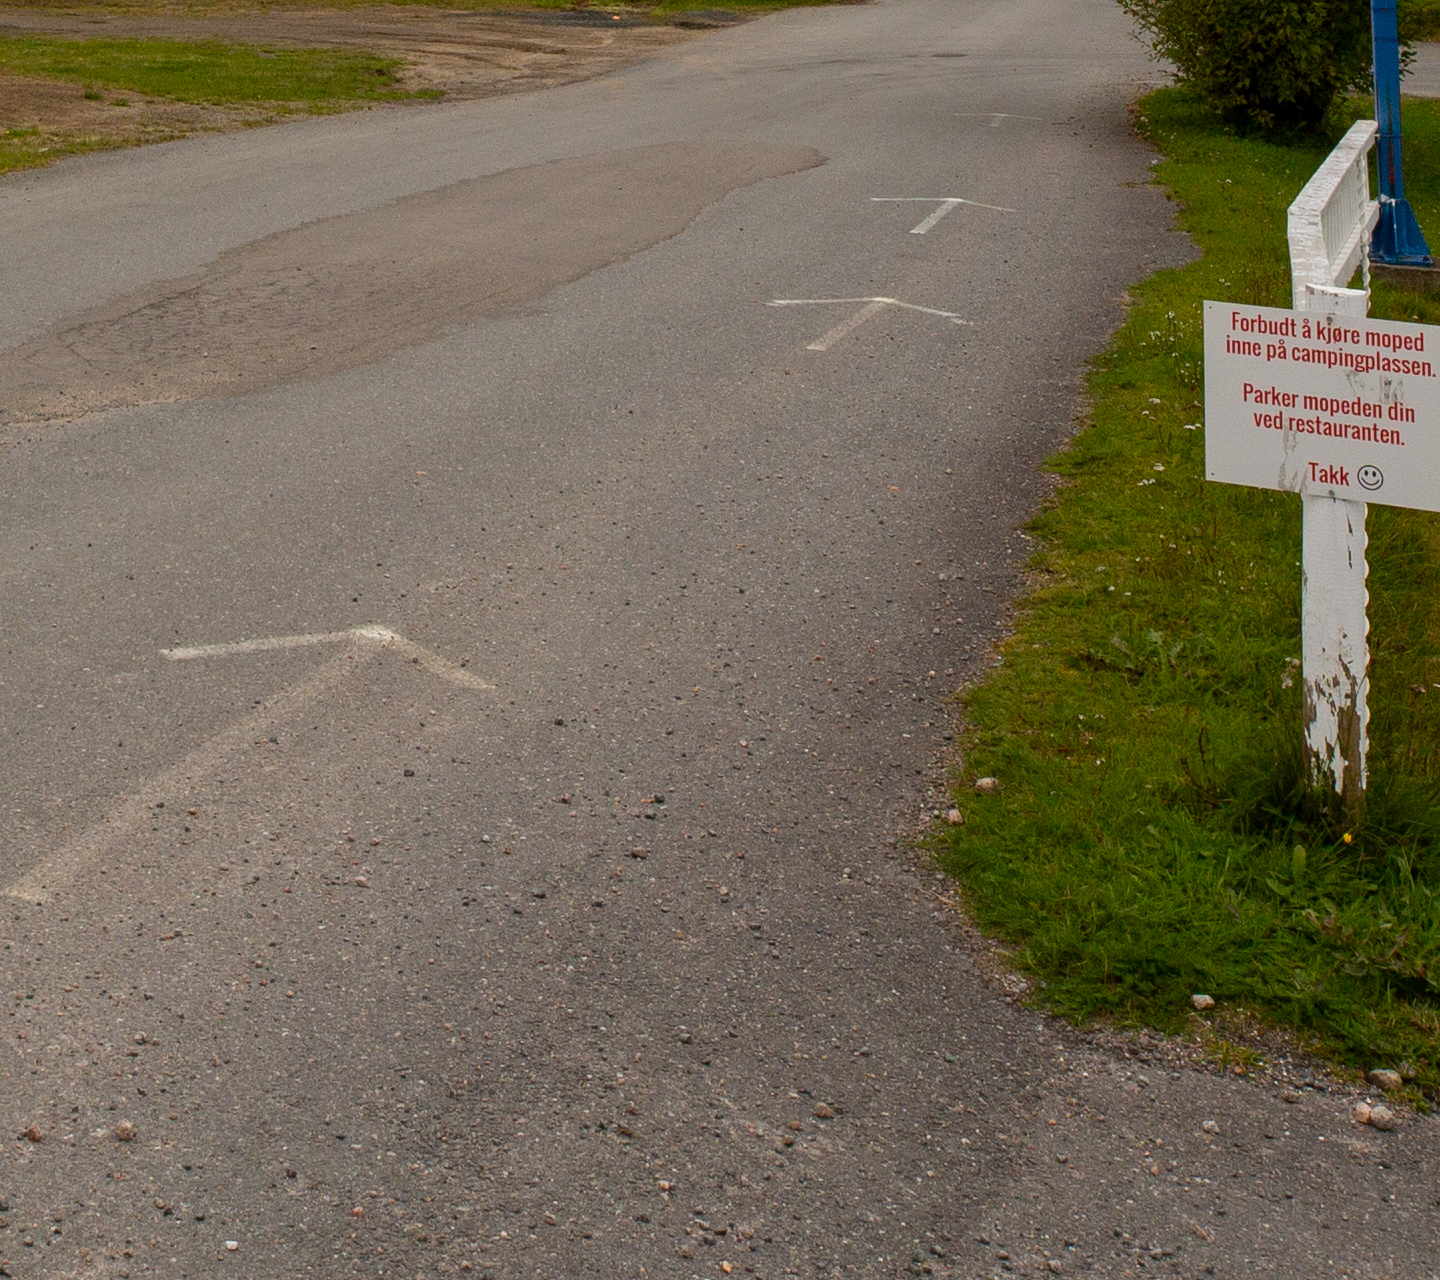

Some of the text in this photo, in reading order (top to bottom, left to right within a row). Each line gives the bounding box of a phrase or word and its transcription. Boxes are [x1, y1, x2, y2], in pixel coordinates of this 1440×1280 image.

[1232, 311, 1425, 352] Forbudt å kjøre moped
[1226, 334, 1437, 378] inne på campingplassen.
[1243, 382, 1415, 423] Parker mopeden din
[1254, 410, 1406, 446] ved restauranten.
[1308, 461, 1350, 486] Takk
